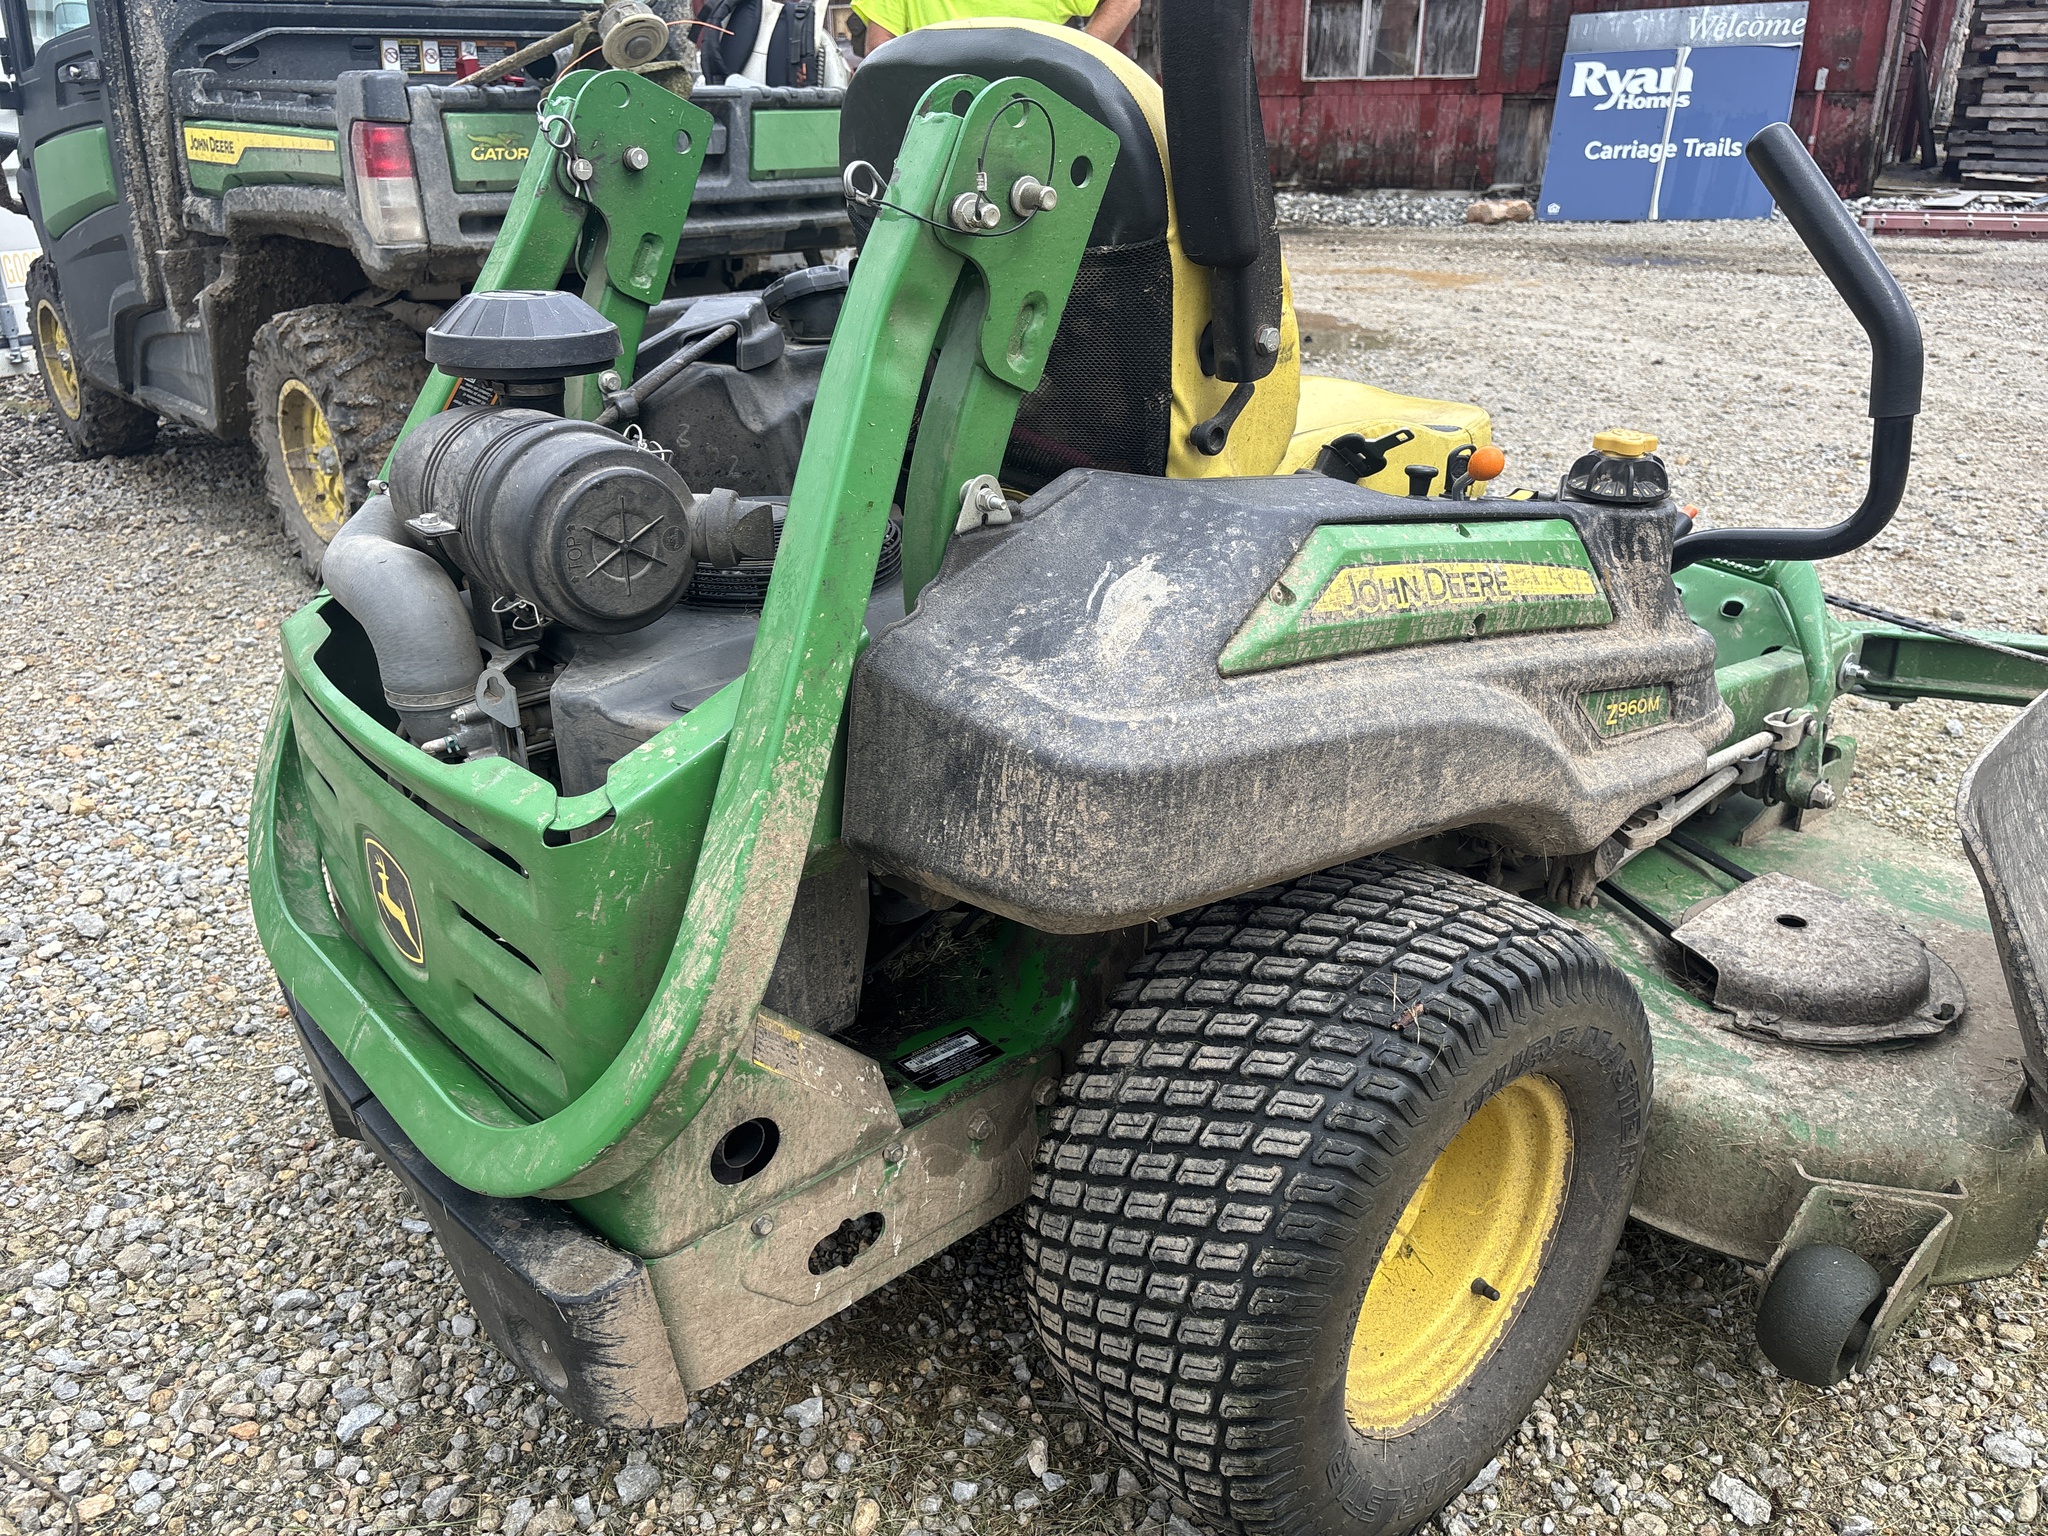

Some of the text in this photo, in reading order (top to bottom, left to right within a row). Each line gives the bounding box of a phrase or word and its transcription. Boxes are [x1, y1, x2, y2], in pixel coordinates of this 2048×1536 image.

[1688, 14, 1806, 41] Welcome
[1569, 61, 1694, 111] Ryan
[190, 135, 235, 154] JOHN DEERE
[470, 146, 530, 162] GATOR
[1584, 138, 1742, 163] Carriage Trails
[566, 536, 583, 571] TOP
[1343, 566, 1512, 609] JOHN DEERE
[1606, 695, 1661, 726] Z960M
